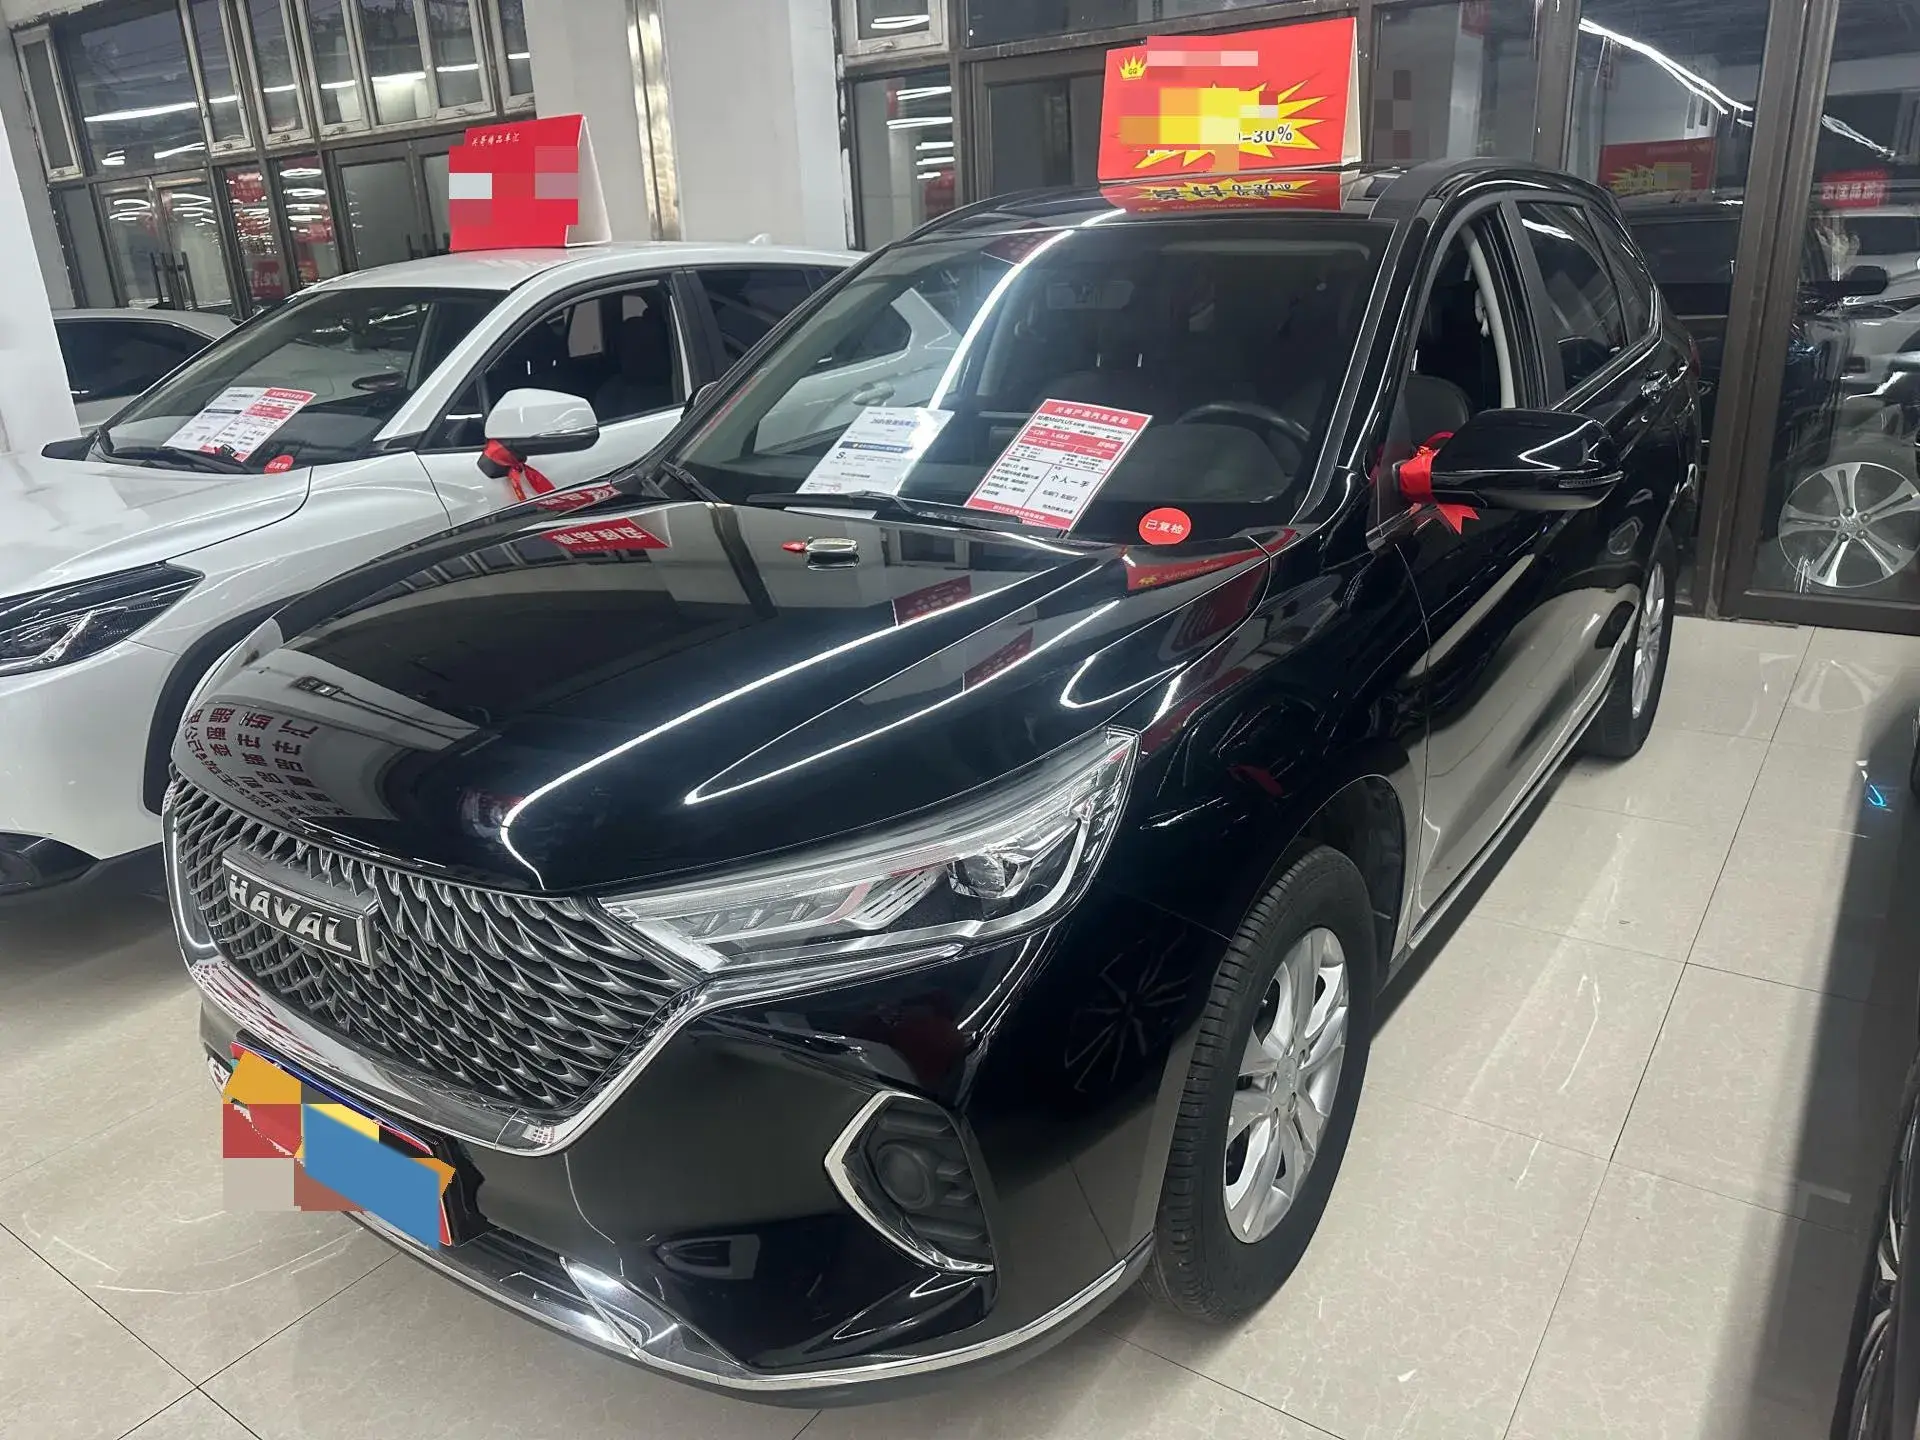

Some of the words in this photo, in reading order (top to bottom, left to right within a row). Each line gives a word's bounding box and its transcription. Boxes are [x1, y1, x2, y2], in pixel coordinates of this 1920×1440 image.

[1144, 519, 1185, 535] 已复检
[228, 875, 353, 952] HAVAL
